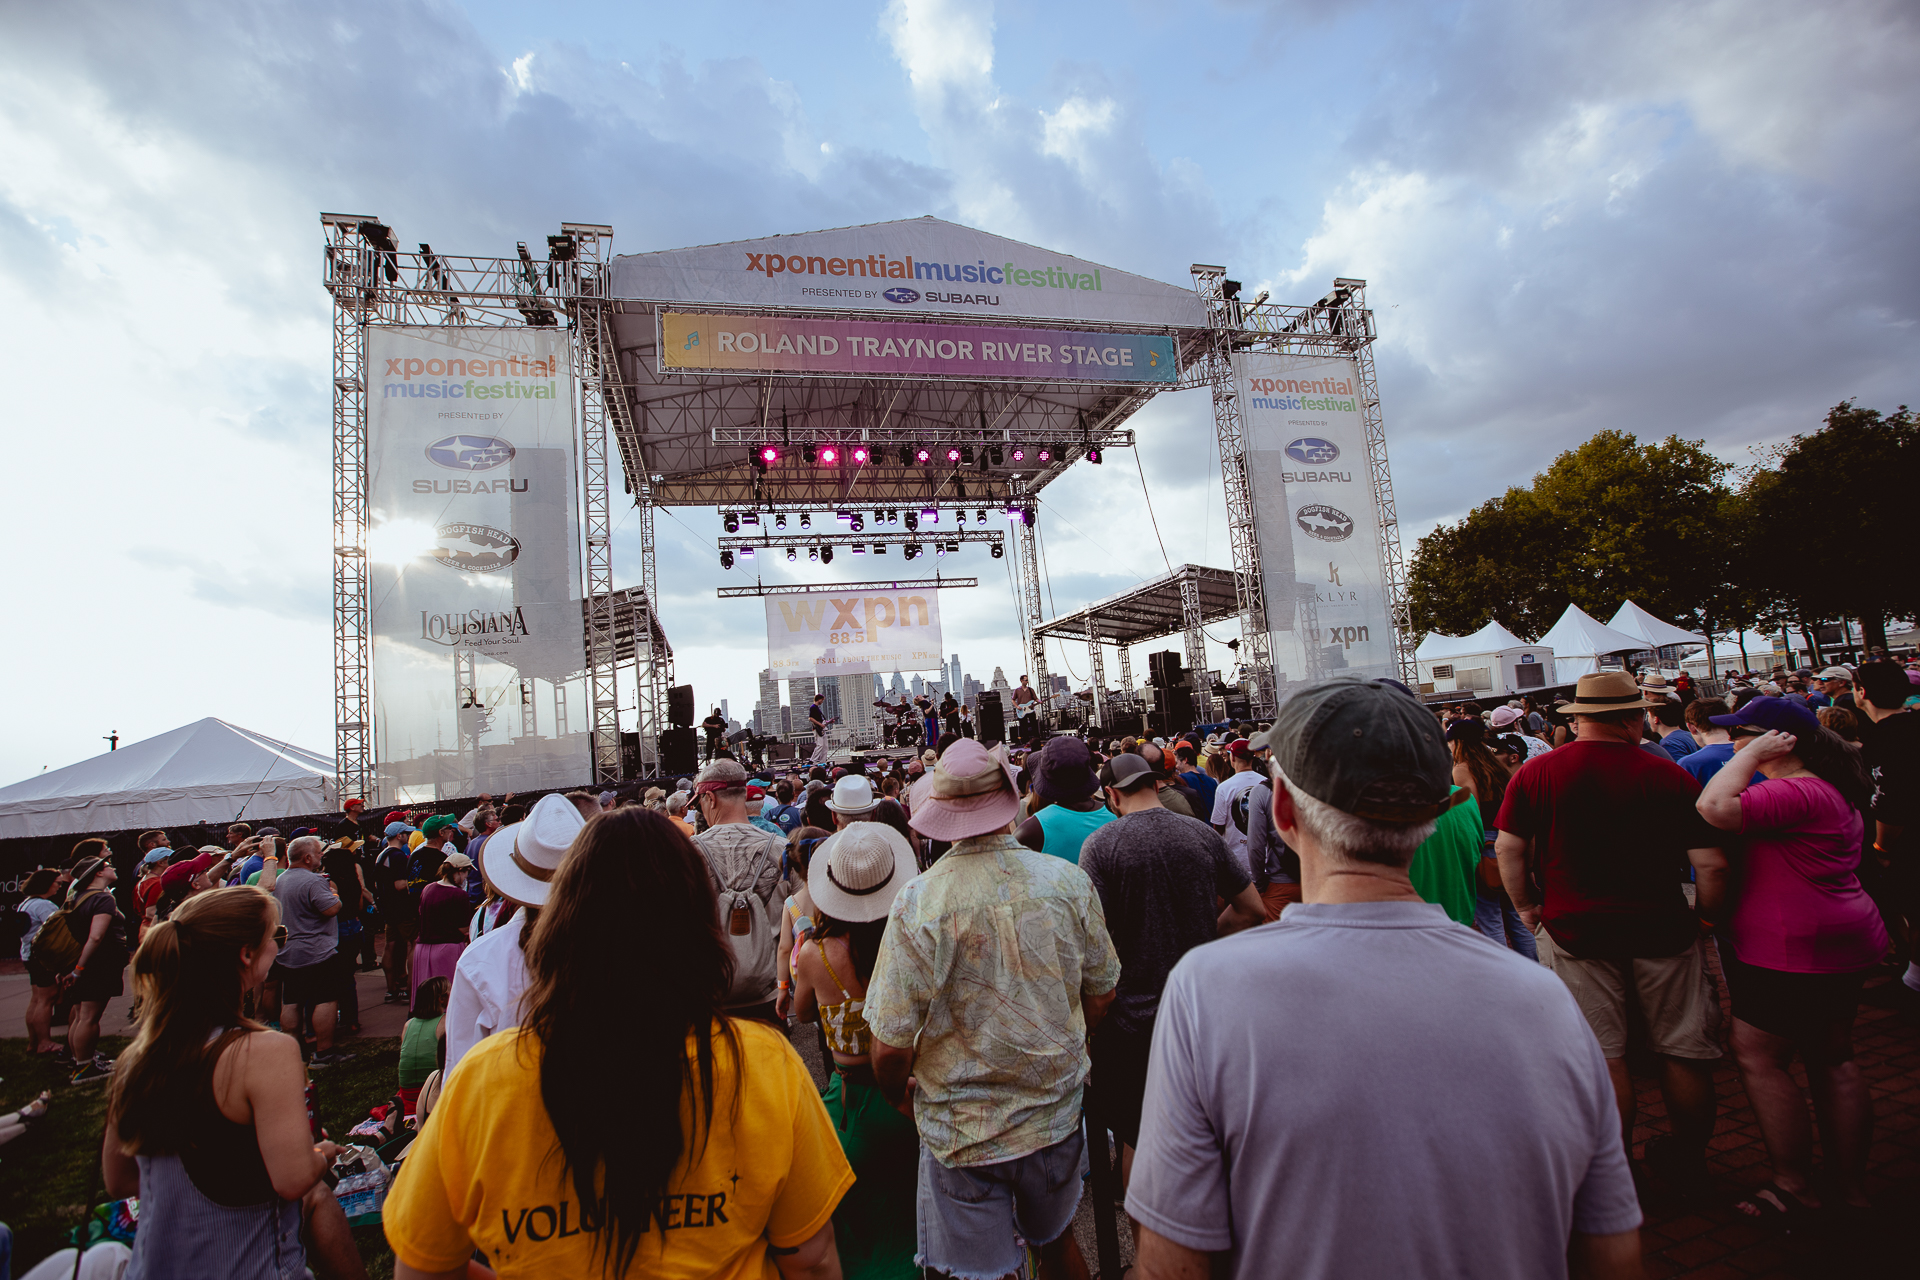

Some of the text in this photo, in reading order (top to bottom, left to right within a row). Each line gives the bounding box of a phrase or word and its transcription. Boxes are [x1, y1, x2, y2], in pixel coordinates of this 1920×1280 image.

[745, 252, 1102, 291] xponentialmusicfestival
[802, 287, 1000, 306] PRESENTED BY SUBARU
[717, 331, 1134, 367] ROLAND TRAYNOR RIVER STAGE
[384, 355, 556, 380] xponential
[383, 380, 556, 399] musicfestival
[1249, 377, 1354, 396] xponential
[1252, 395, 1357, 412] musicfestival
[438, 412, 504, 420] PRESENTED BY
[1281, 471, 1351, 483] SUBARU
[412, 478, 529, 494] SUBARU
[1302, 506, 1348, 522] DOGFISH HEAD
[439, 525, 511, 545] DOGFISH HEAD
[442, 557, 460, 567] BEER
[468, 562, 501, 571] COCKTAILS
[1315, 591, 1358, 603] KLYR
[777, 595, 929, 643] wxpn
[502, 636, 522, 644] Soul.
[829, 631, 865, 645] 88.5
[812, 653, 902, 665] IT'S ALL ABOUT THE MUSIC
[502, 1192, 729, 1244] VOLUEER
